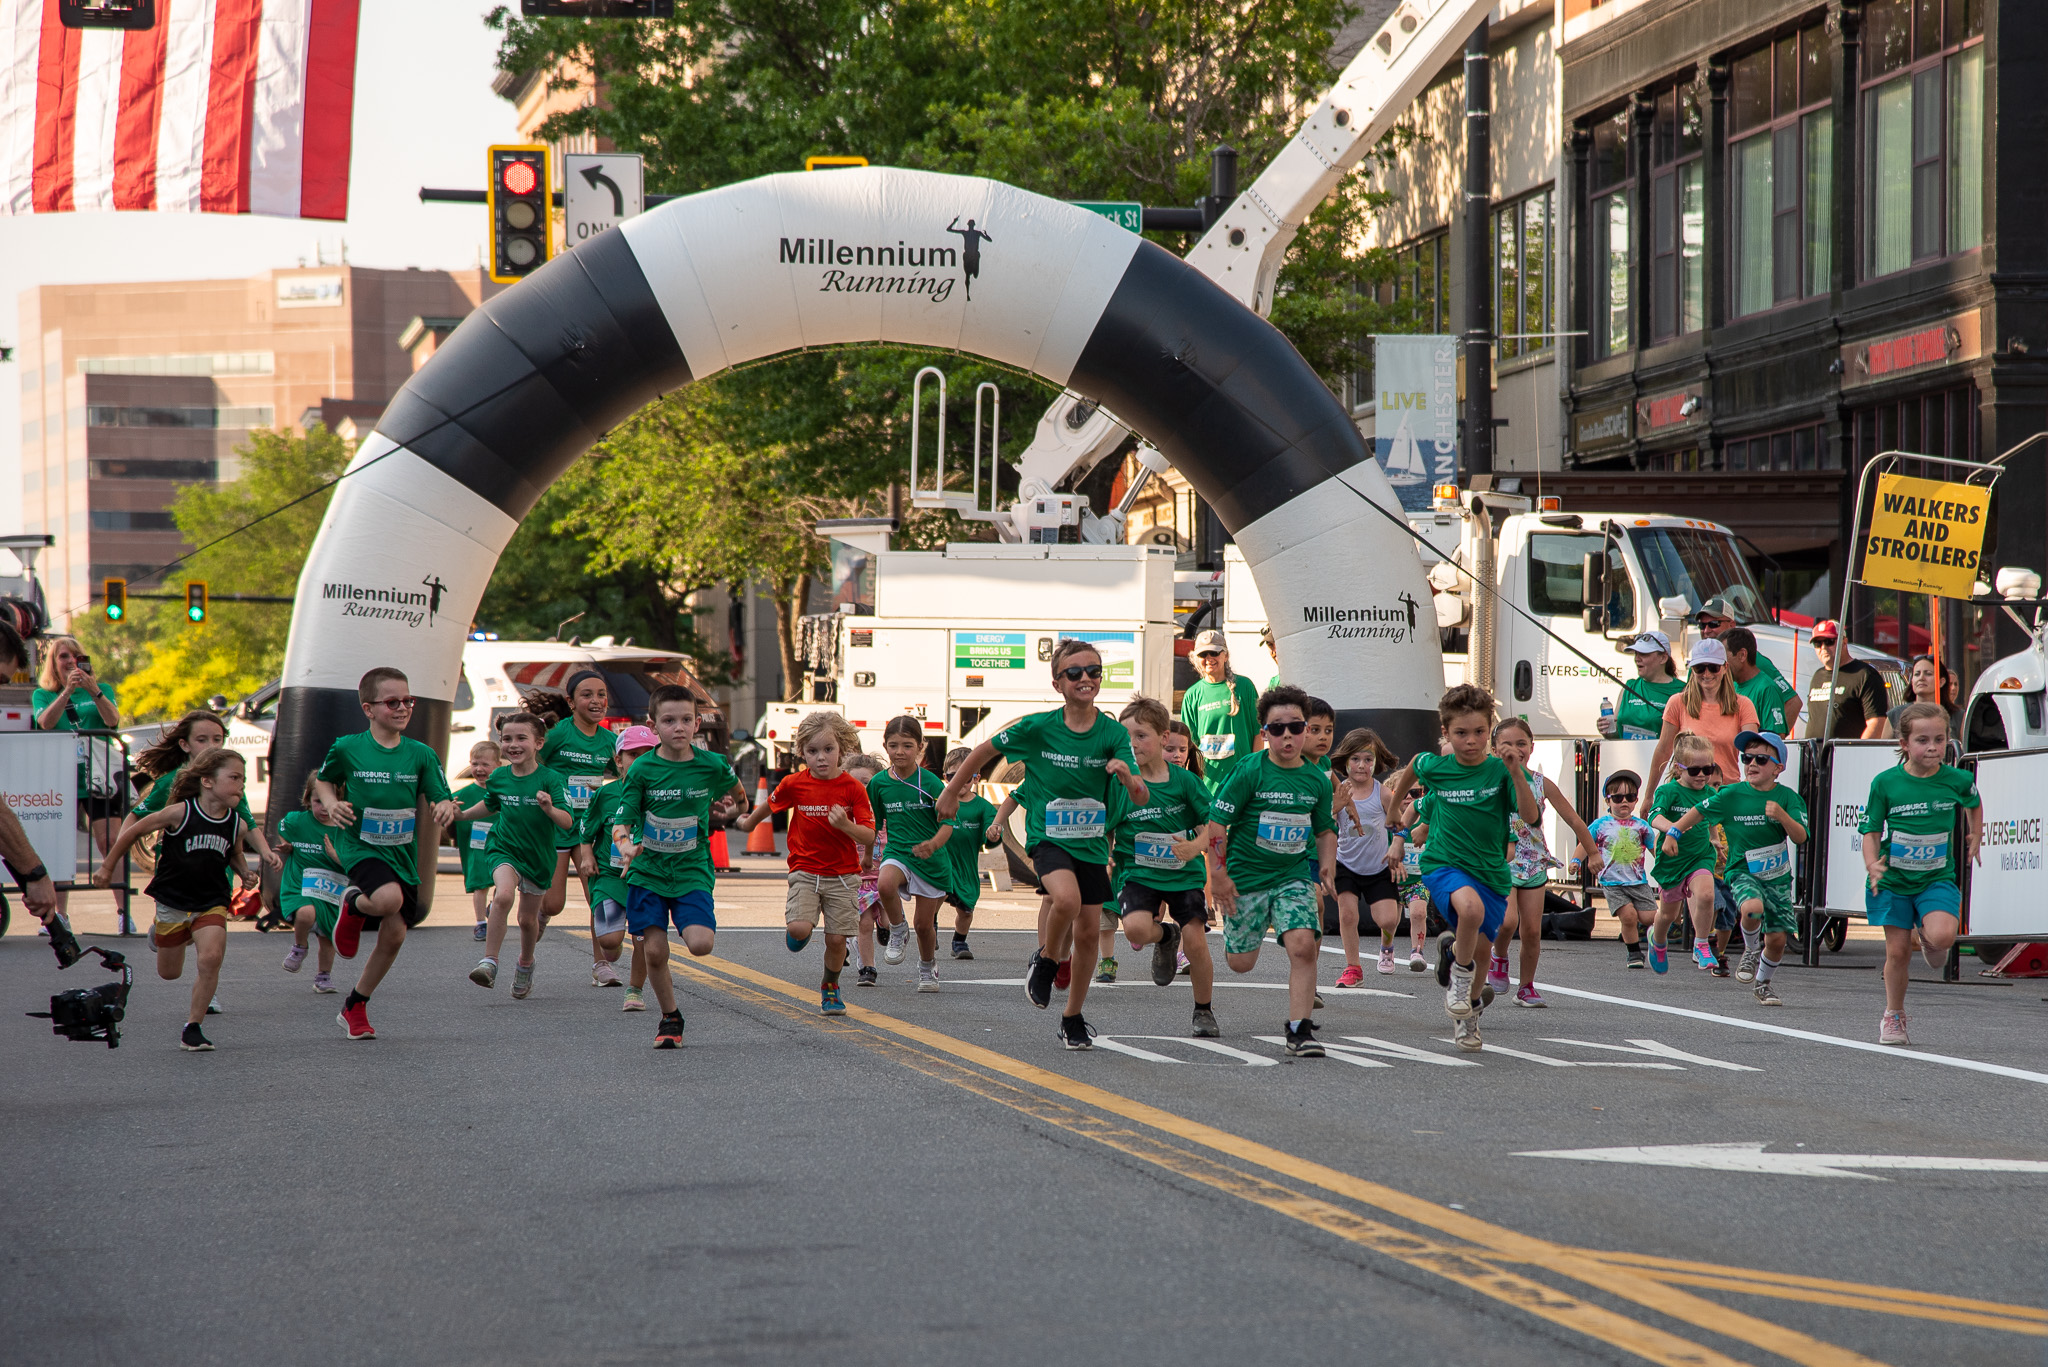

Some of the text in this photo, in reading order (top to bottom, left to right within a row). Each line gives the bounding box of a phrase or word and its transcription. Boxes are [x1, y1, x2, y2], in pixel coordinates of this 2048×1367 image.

[1125, 210, 1138, 228] St
[577, 222, 610, 239] ON
[779, 237, 957, 267] Millennium
[819, 269, 956, 303] Running
[1382, 391, 1427, 411] LIVE
[1883, 493, 1980, 524] WALKERS
[1904, 519, 1949, 542] AND
[1868, 536, 1979, 570] STROLLERS
[1893, 578, 1943, 592] Millennium Running
[323, 583, 427, 606] Millennium
[342, 602, 425, 628] Running
[1303, 605, 1405, 622] Millennium
[975, 635, 1006, 643] ENERGY
[1327, 623, 1405, 643] Running
[969, 646, 1012, 656] BRINGS US
[970, 659, 1010, 668] TOGETHER
[560, 751, 592, 760] EVERSOURCE
[1042, 751, 1079, 763] EVERSOURCE
[353, 771, 390, 779] EVERSOURCE
[3, 789, 63, 807] terseals
[1256, 791, 1294, 800] EVERSOURCE
[1127, 807, 1162, 819] EVERSOURCE
[1214, 799, 1236, 813] 2023
[1889, 802, 1928, 814] EVERSOURCE
[18, 809, 63, 822] Hampshire
[1055, 811, 1098, 825] 1167
[377, 820, 404, 834] 131
[1268, 825, 1306, 841] 1162
[1981, 818, 2040, 846] EVERSOURCE
[654, 829, 686, 842] 129
[1402, 852, 1420, 866] 34
[1903, 846, 1936, 859] 249
[1759, 854, 1783, 871] 737
[2001, 851, 2040, 871] Walk & 5K Run
[314, 878, 339, 894] 457
